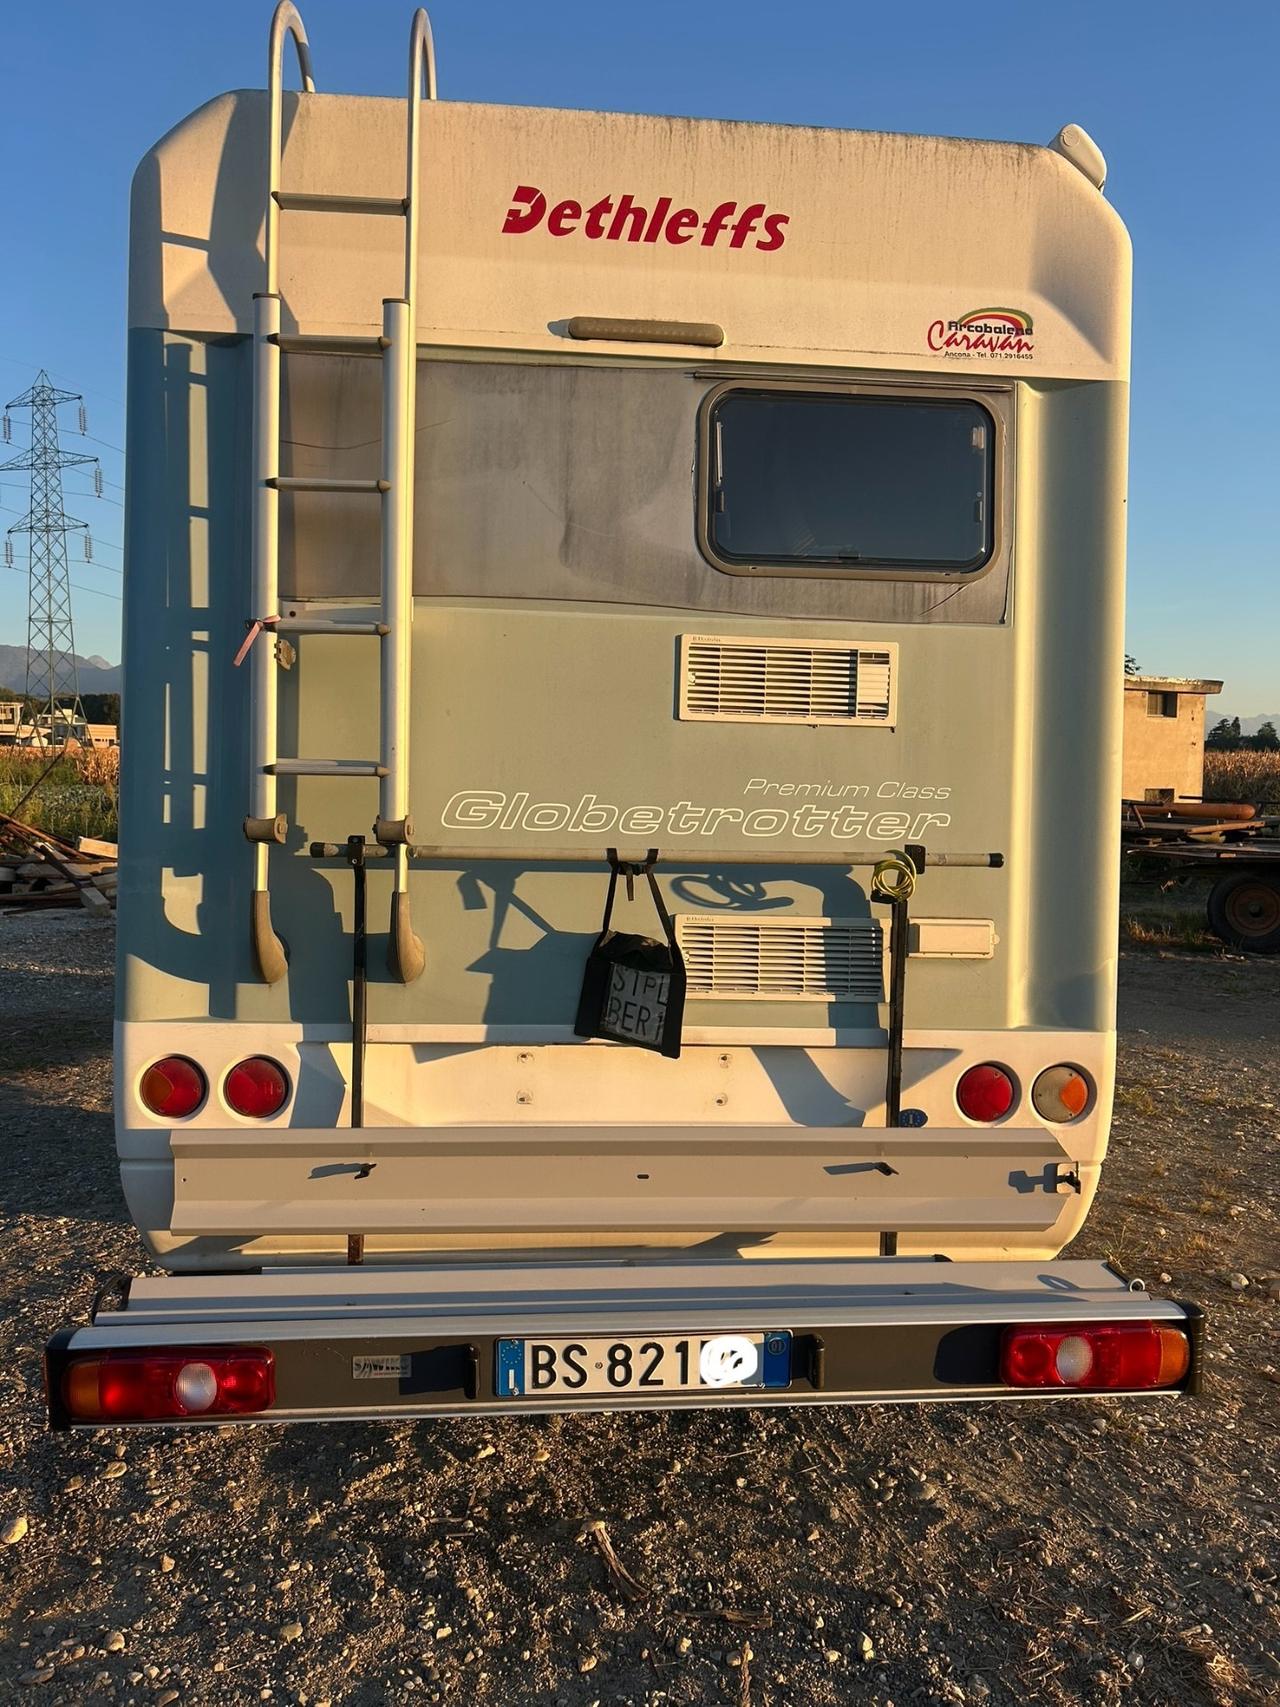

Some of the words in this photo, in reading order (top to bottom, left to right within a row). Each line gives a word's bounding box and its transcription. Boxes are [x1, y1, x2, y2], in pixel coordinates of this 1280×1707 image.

[501, 185, 790, 251] Dethleffs
[927, 320, 1034, 353] Caravan
[948, 321, 1033, 336] Arcobaleno
[944, 350, 971, 358] Ancona
[743, 778, 870, 798] Premium
[876, 781, 951, 800] Class
[441, 790, 951, 841] Globetrotter
[531, 1344, 587, 1389] BS
